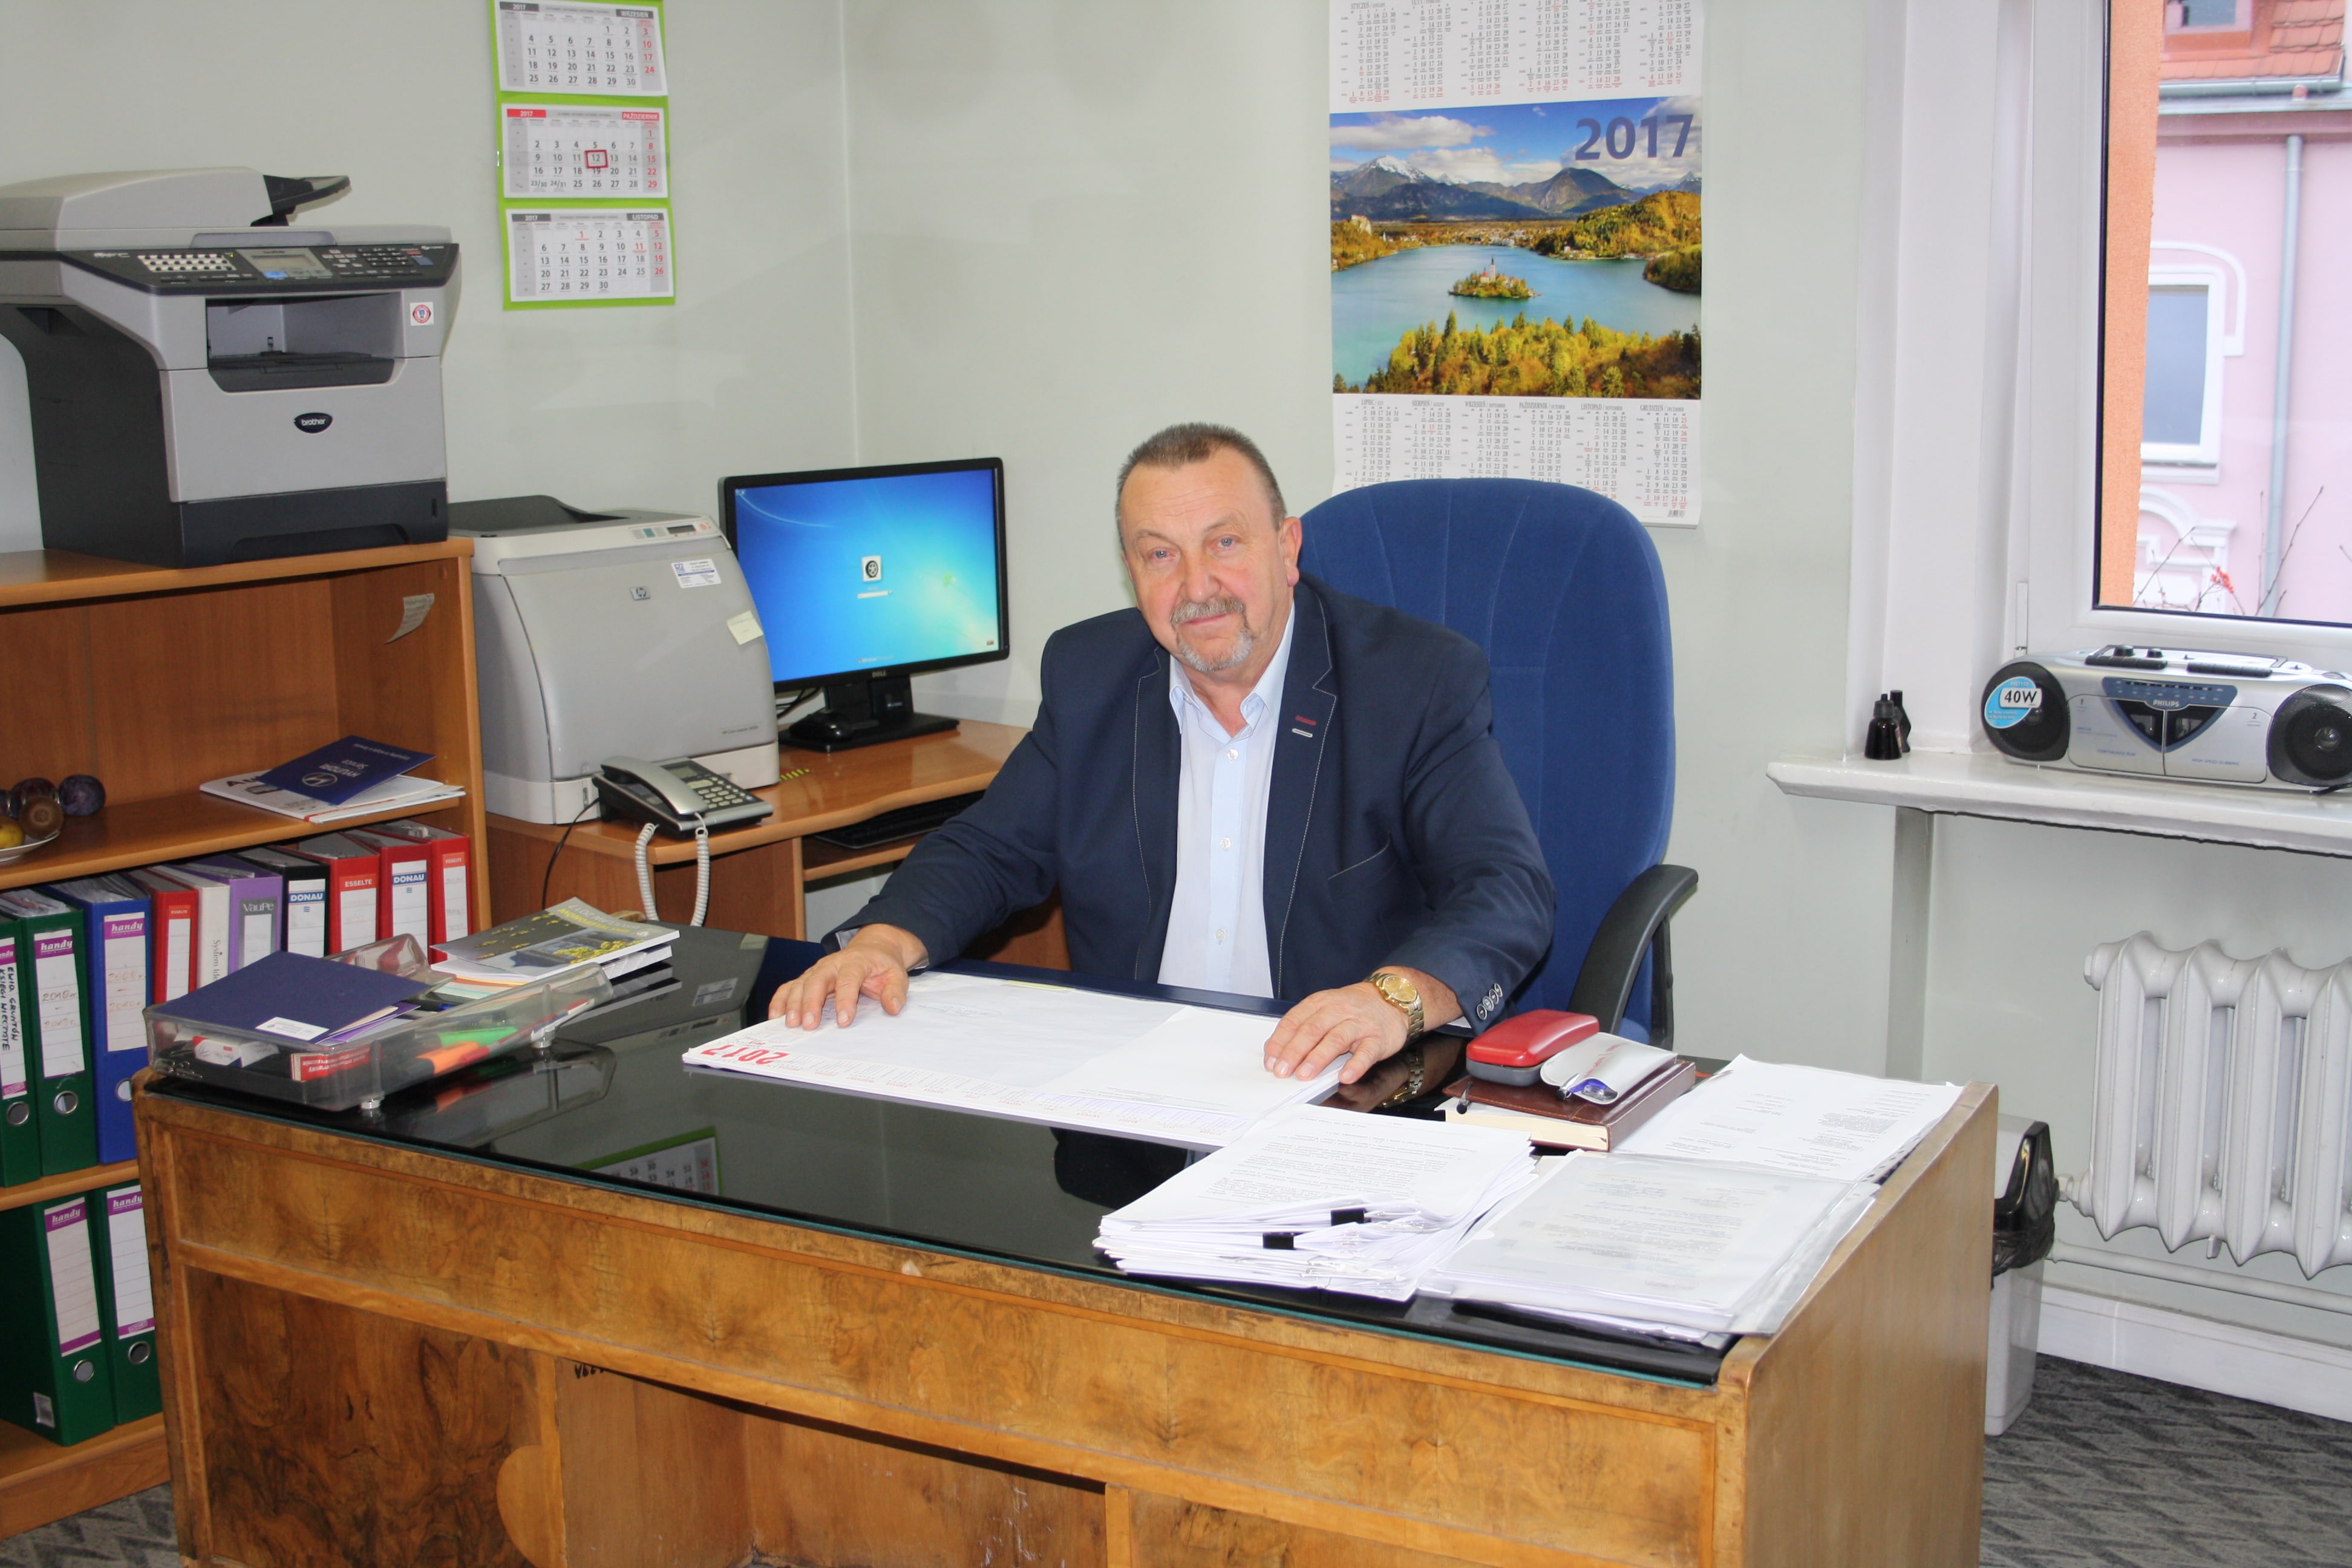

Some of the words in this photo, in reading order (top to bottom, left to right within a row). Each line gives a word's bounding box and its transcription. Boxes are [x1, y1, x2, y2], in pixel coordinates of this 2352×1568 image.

[624, 26, 629, 34] 2
[643, 27, 648, 36] 3
[549, 35, 554, 44] 5
[587, 37, 592, 45] 7
[606, 38, 612, 47] 8
[625, 39, 630, 48] 9
[547, 48, 557, 57] 12
[567, 50, 577, 58] 13
[586, 50, 596, 59] 14
[606, 51, 615, 59] 15
[624, 52, 634, 60] 16
[643, 53, 653, 61] 17
[528, 60, 538, 70] 18
[548, 62, 558, 70] 19
[567, 62, 578, 71] 20
[587, 63, 596, 71] 21
[606, 64, 616, 73] 22
[625, 65, 635, 73] 23
[644, 65, 655, 74] 24
[529, 74, 539, 83] 25
[588, 76, 598, 85] 28
[607, 77, 617, 85] 29
[626, 77, 636, 86] 30
[1575, 113, 1694, 161] 2017
[535, 140, 540, 148] 2
[555, 140, 560, 149] 3
[611, 141, 616, 149] 6
[535, 153, 541, 162] 9
[647, 155, 656, 163] 15
[534, 166, 544, 175] 16
[554, 166, 563, 175] 17
[629, 167, 637, 175] 21
[573, 180, 583, 188] 25
[610, 180, 619, 188] 27
[629, 180, 638, 188] 28
[598, 230, 603, 238] 2
[654, 229, 659, 238] 5
[541, 244, 547, 252] 6
[561, 243, 566, 252] 7
[599, 243, 604, 251] 9
[635, 242, 644, 250] 11
[540, 256, 550, 265] 13
[579, 256, 589, 264] 15
[598, 255, 608, 264] 16
[617, 255, 626, 263] 17
[560, 269, 569, 278] 21
[580, 269, 589, 277] 22
[599, 268, 608, 276] 23
[655, 267, 664, 275] 26
[541, 283, 550, 291] 27
[561, 282, 570, 290] 28
[580, 281, 590, 290] 29
[599, 281, 609, 289] 30
[2004, 690, 2037, 704] 40W
[344, 878, 373, 888] ESSELTE
[393, 874, 425, 884] DONAU
[290, 892, 323, 902] DONAU
[243, 902, 275, 912] VauPe
[111, 922, 143, 932] handy
[41, 939, 73, 951] handy
[212, 939, 221, 967] System
[701, 1045, 790, 1065] 2017
[113, 1195, 142, 1208] handy
[52, 1209, 80, 1223] handy
